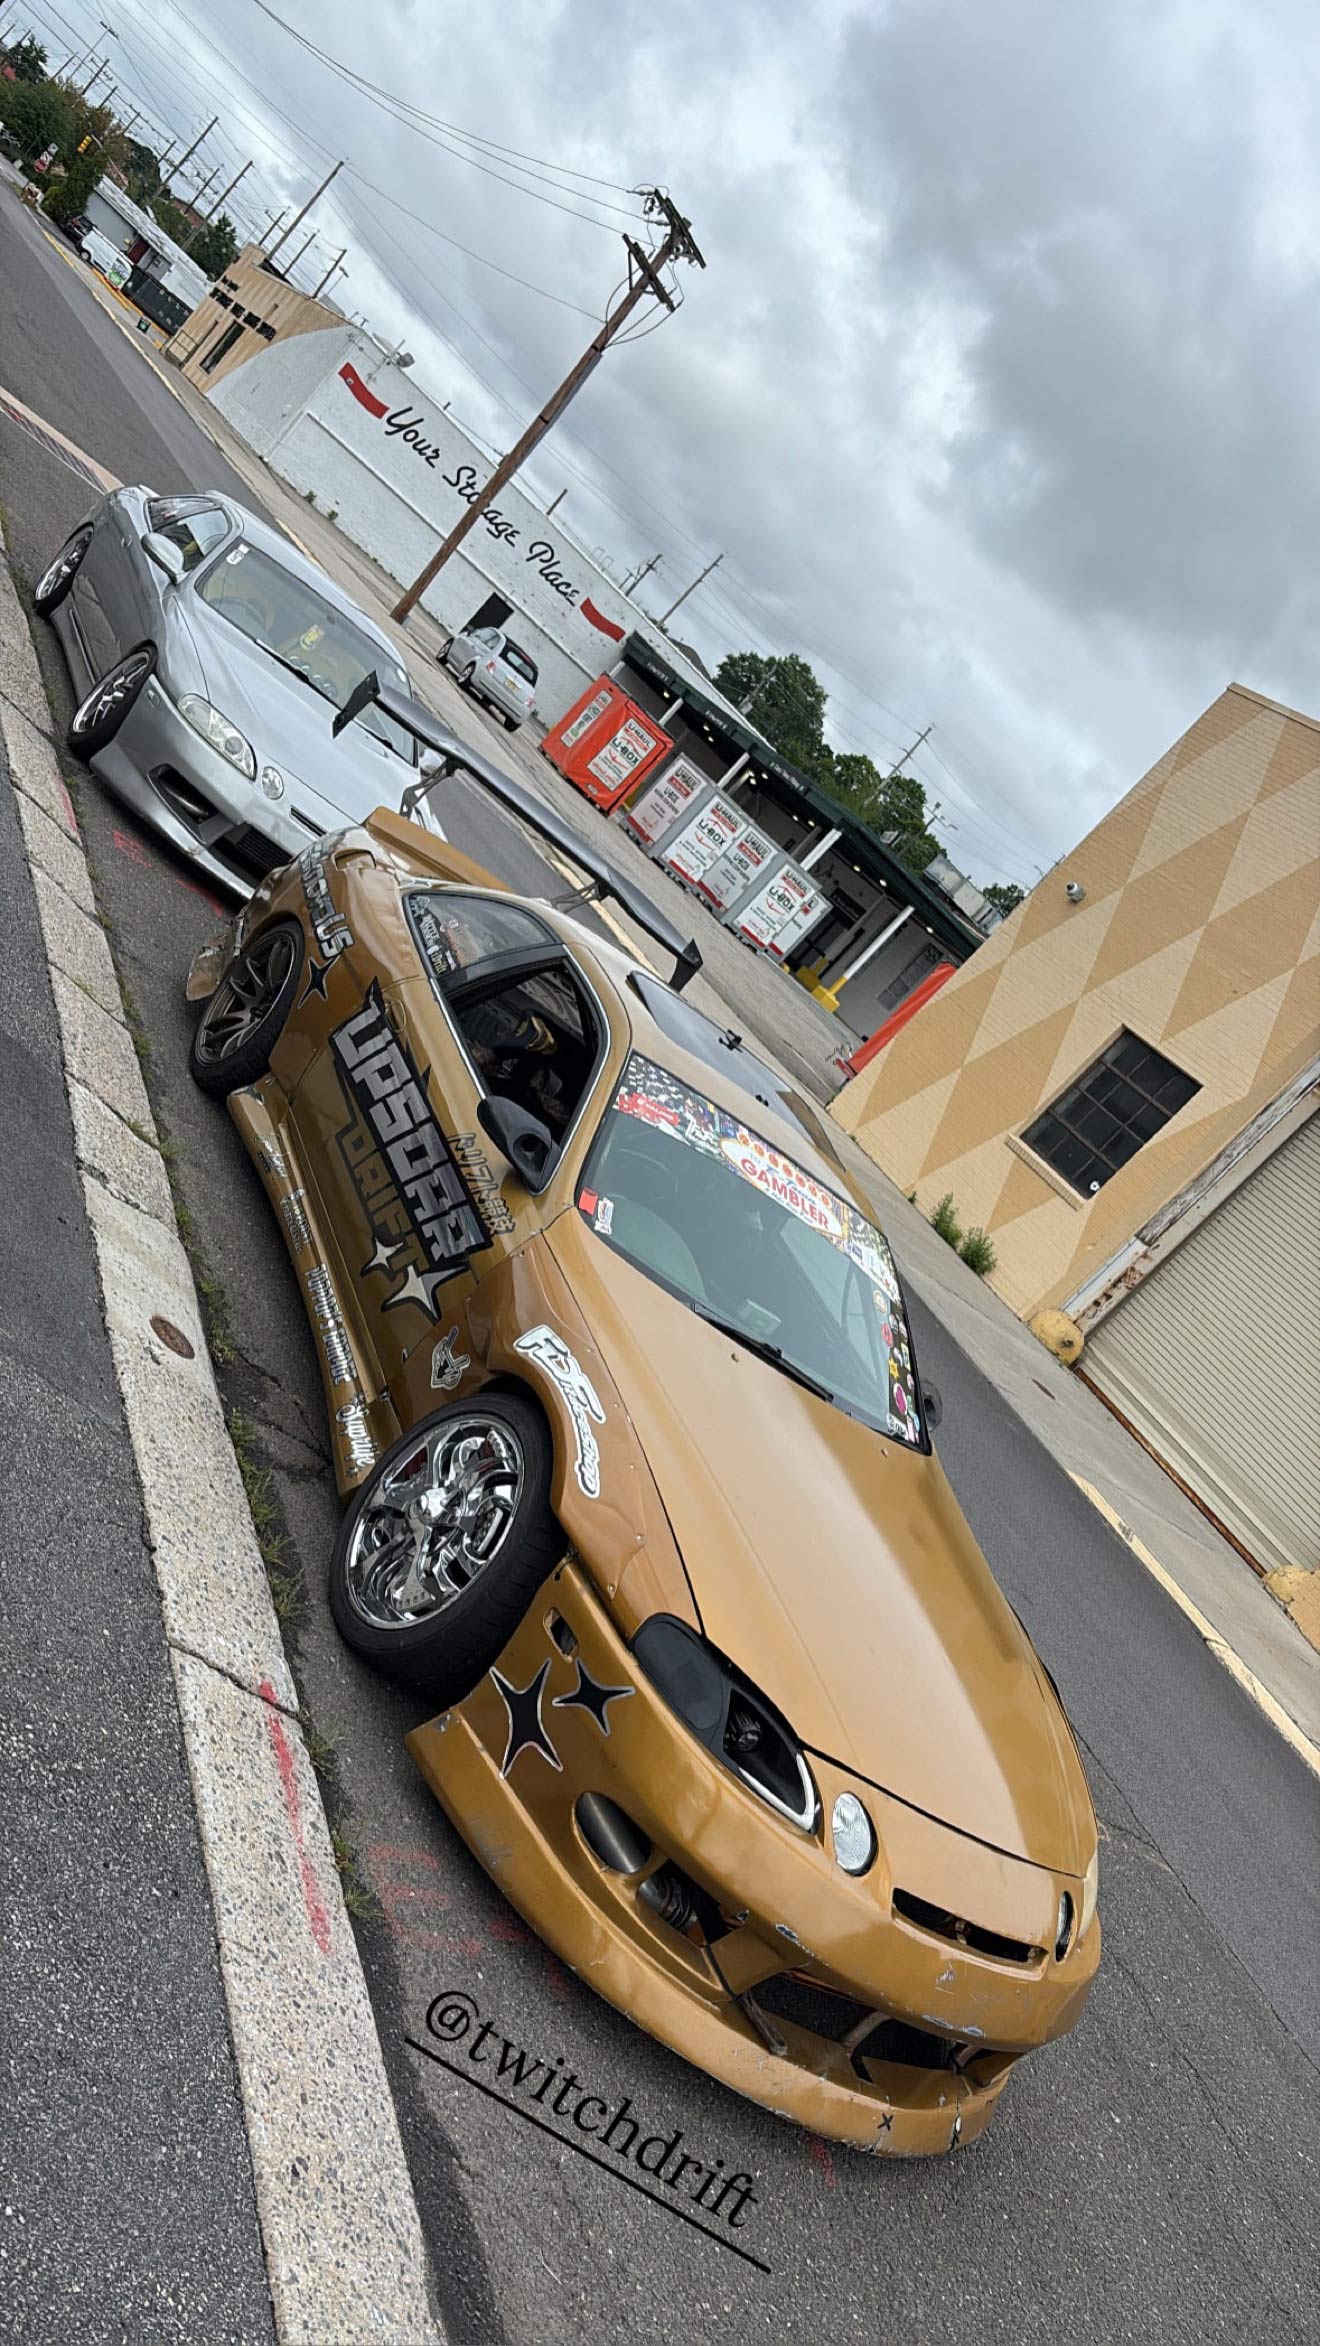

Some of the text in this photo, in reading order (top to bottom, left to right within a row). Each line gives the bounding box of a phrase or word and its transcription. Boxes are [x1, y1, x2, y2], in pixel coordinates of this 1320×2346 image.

[385, 407, 580, 606] Your Stoage Place
[628, 723, 651, 748] U-HAUL
[612, 737, 639, 765] U-BOX
[675, 768, 697, 791] U-HAUL
[715, 803, 740, 827] U-HAUL
[699, 819, 726, 846] U-BOX
[745, 834, 768, 859] U-HAUL
[786, 870, 808, 893] U-HAUL
[769, 886, 795, 910] U-BOX
[332, 994, 485, 1262] UPSOAR
[341, 1125, 430, 1273] DRIFT
[741, 1158, 828, 1229] GAMBLER
[322, 1328, 358, 1387] GARAGE
